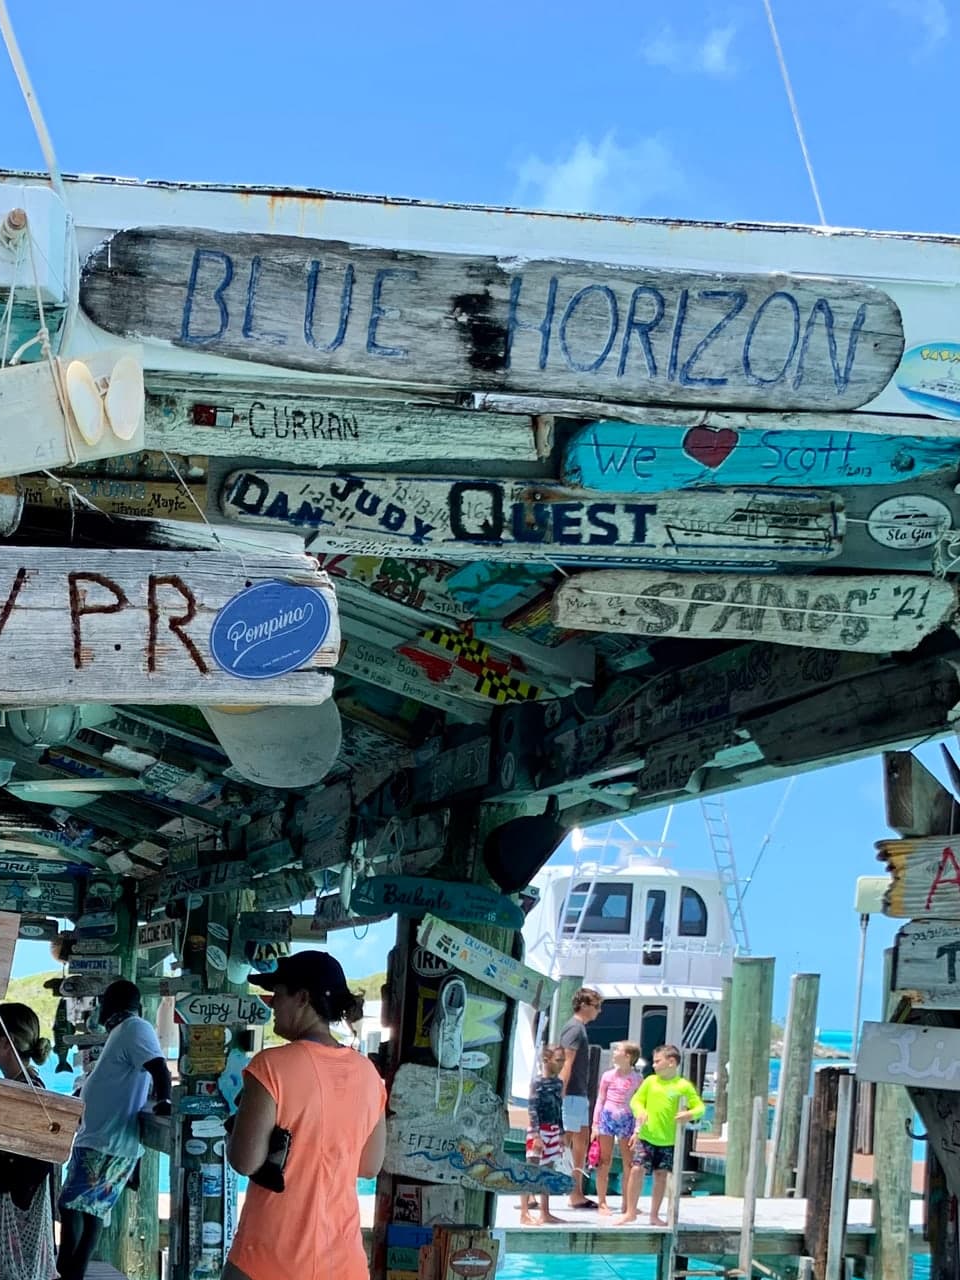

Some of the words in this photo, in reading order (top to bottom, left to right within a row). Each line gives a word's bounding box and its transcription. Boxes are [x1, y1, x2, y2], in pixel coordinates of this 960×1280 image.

[180, 248, 419, 360] BLUE
[504, 274, 868, 395] HORIZON
[247, 400, 360, 440] CURRAN
[592, 431, 658, 481] We
[760, 430, 856, 474] Scott
[231, 472, 332, 528] DAN
[329, 475, 436, 545] JUDY
[450, 481, 658, 547] QUEST
[911, 527, 934, 543] Gin
[228, 603, 314, 651] Pompina
[189, 998, 232, 1024] Enjoy
